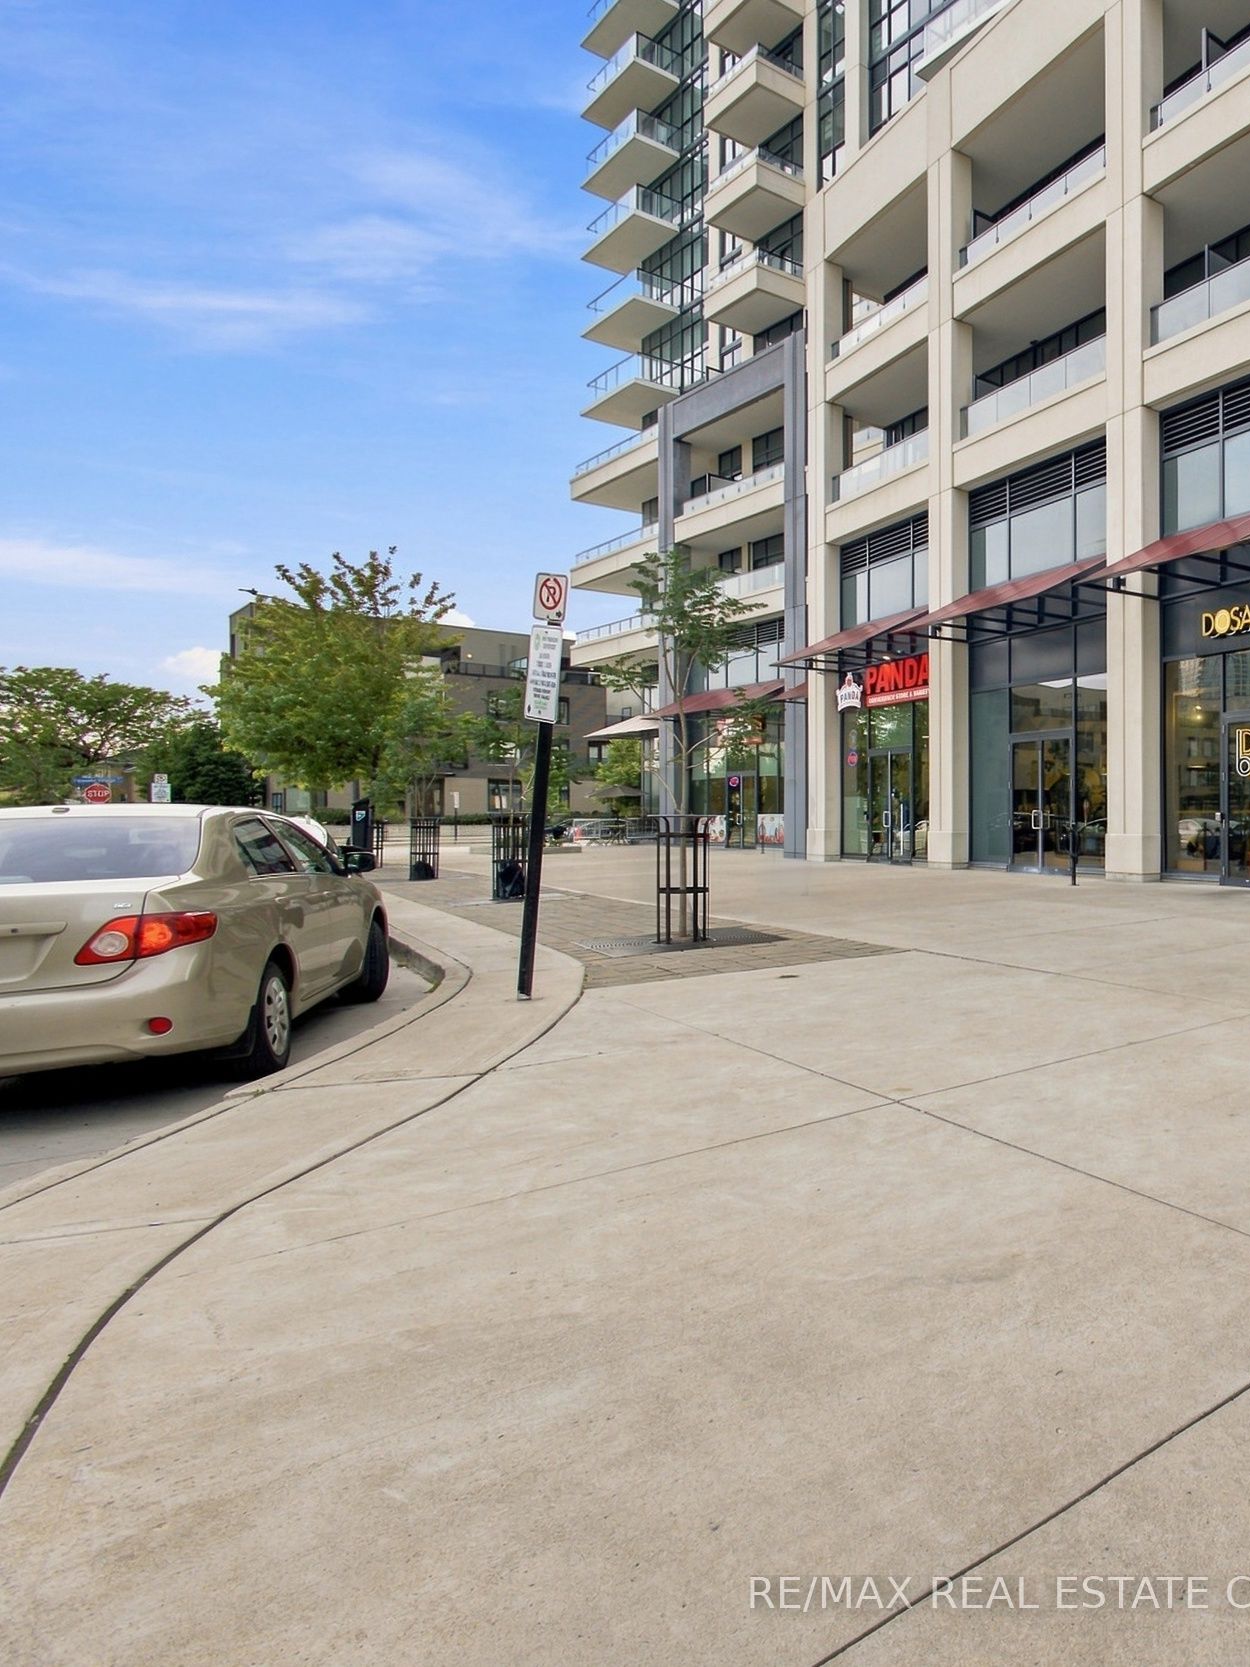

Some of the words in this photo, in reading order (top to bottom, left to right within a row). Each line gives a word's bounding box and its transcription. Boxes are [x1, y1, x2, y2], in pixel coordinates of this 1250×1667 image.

[865, 654, 929, 694] PANDA
[840, 689, 860, 704] PANDA
[87, 790, 110, 798] STOP
